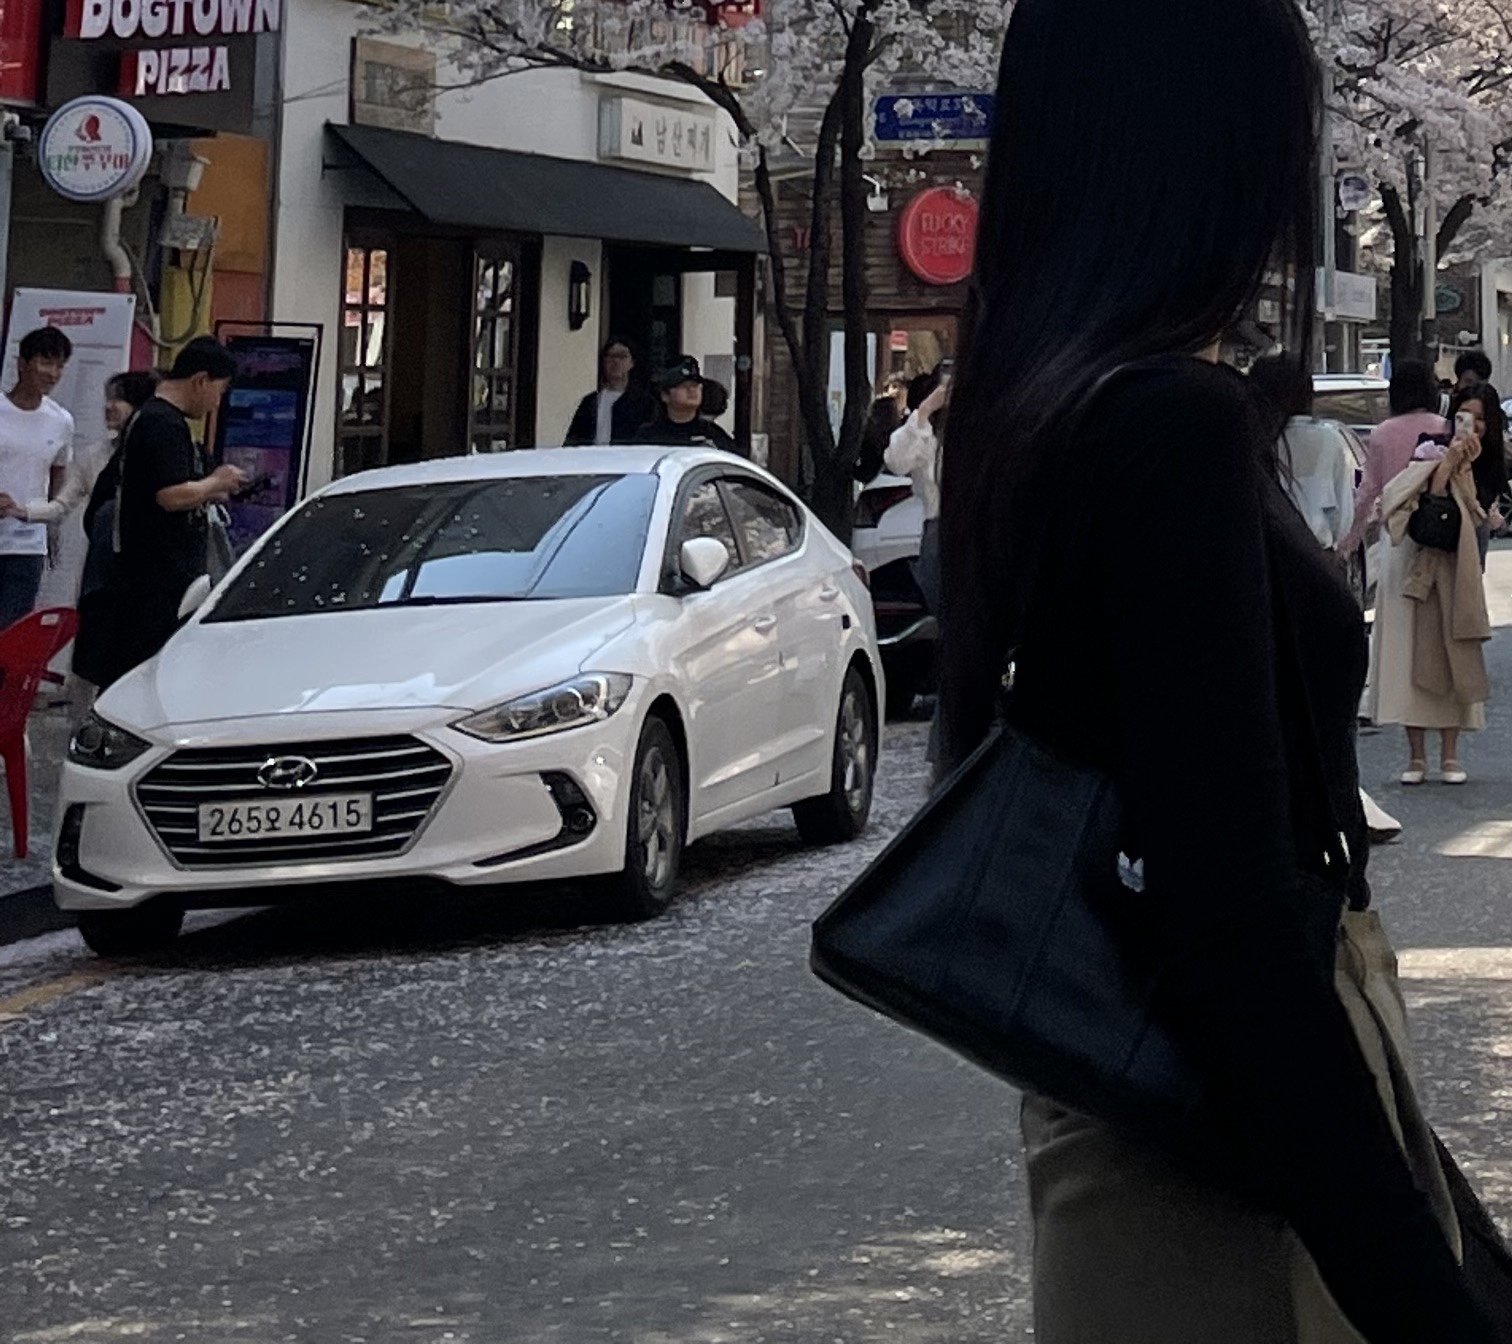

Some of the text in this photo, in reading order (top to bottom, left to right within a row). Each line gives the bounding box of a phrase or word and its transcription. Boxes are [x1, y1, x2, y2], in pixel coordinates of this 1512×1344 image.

[134, 46, 231, 96] PIZZA
[209, 798, 362, 837] 265오 4615
